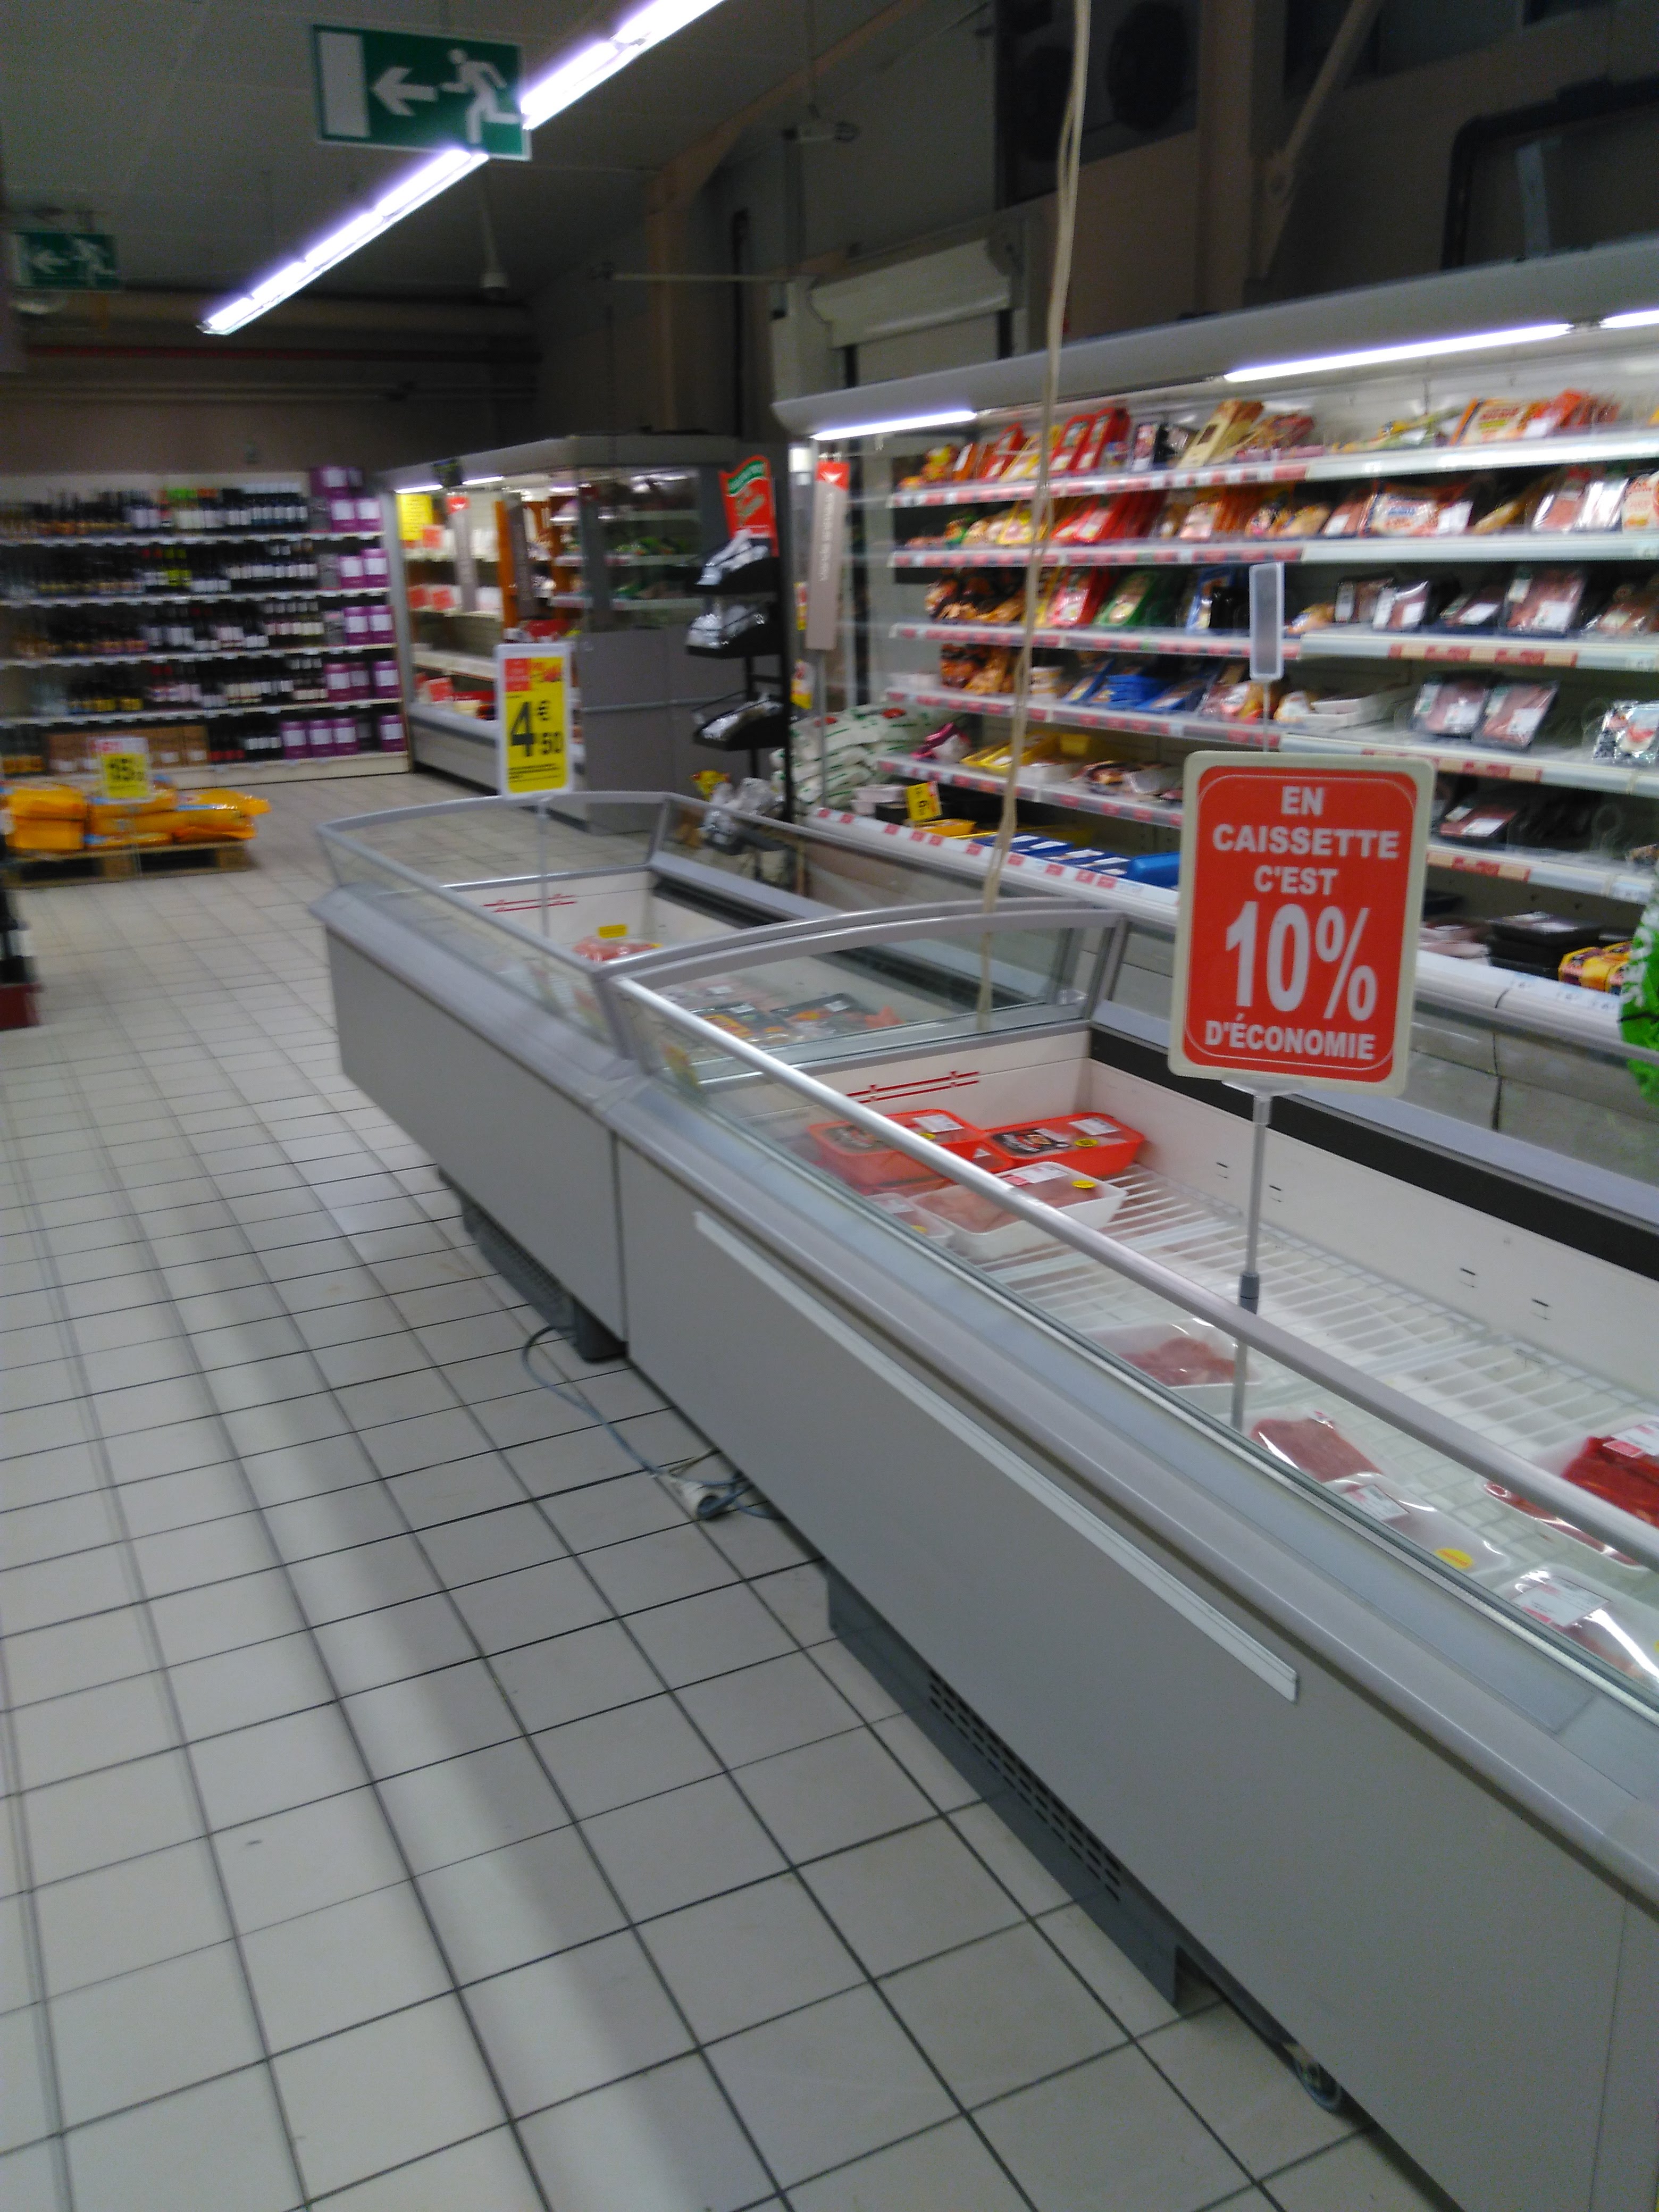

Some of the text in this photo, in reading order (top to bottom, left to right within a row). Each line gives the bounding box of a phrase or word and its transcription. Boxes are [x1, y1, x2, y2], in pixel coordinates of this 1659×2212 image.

[510, 701, 535, 757] 4
[1281, 786, 1323, 816] EN
[1213, 824, 1400, 858] CAISSETTE
[1254, 865, 1338, 895] C'EST
[1226, 901, 1376, 1020] 10%
[1204, 1012, 1376, 1060] D'ÉCONOMIE
